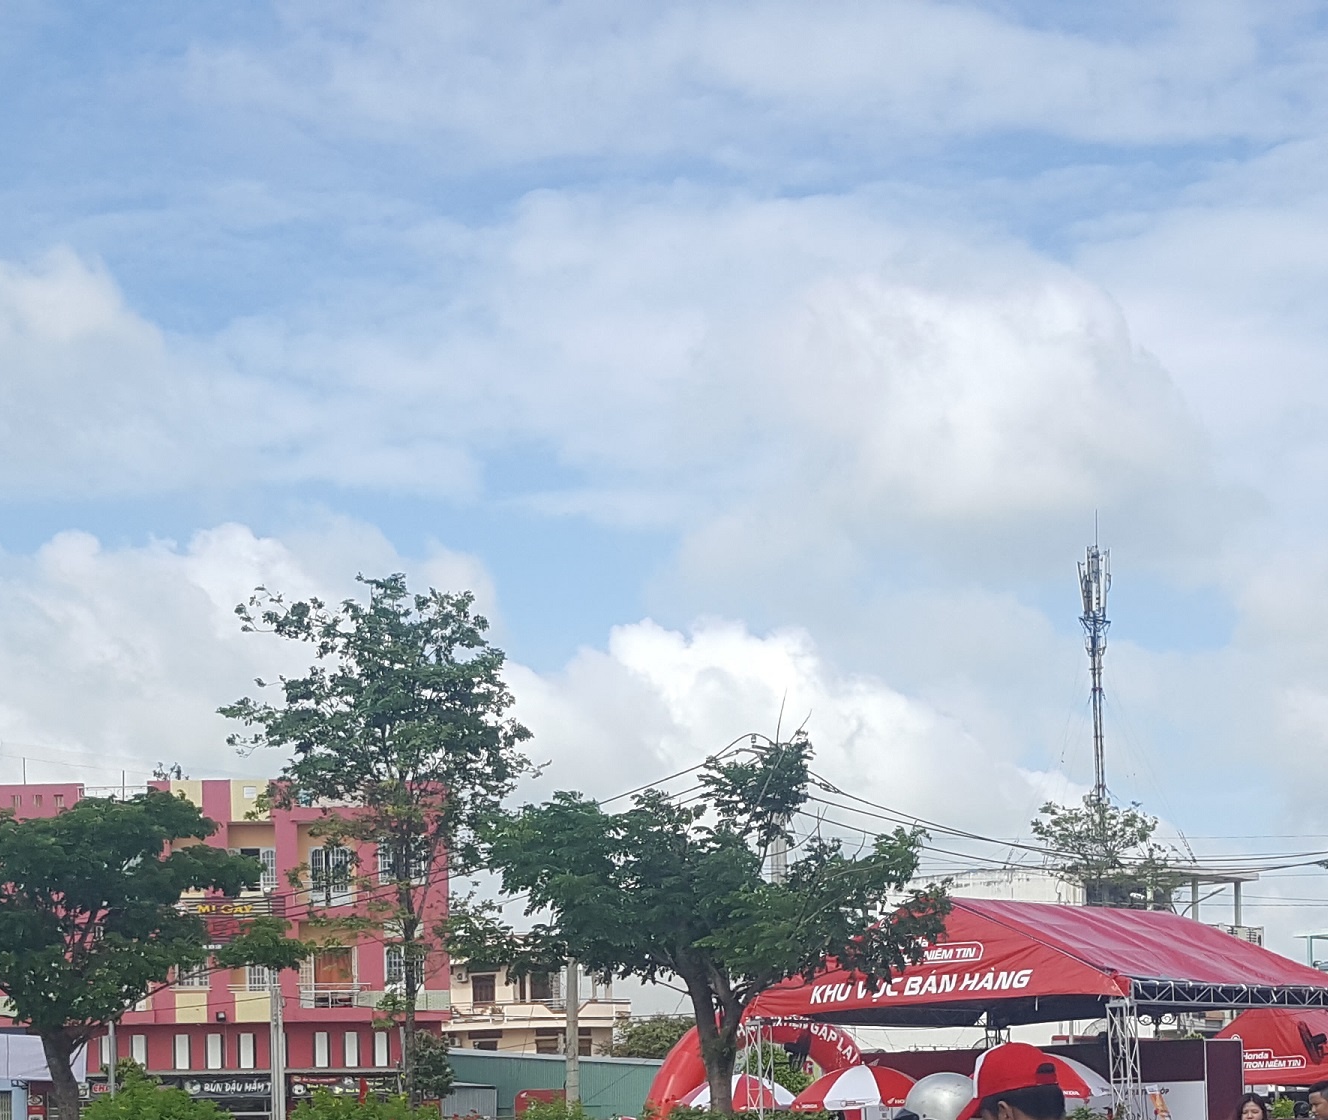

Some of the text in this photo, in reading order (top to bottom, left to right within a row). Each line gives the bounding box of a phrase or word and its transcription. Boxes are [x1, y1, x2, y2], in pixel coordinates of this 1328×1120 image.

[955, 946, 978, 958] TIN
[810, 983, 853, 1004] KHU
[904, 970, 958, 996] BÁN
[958, 967, 1035, 991] HÀNG
[1287, 1059, 1302, 1067] TIN
[203, 1080, 222, 1092] BÚN
